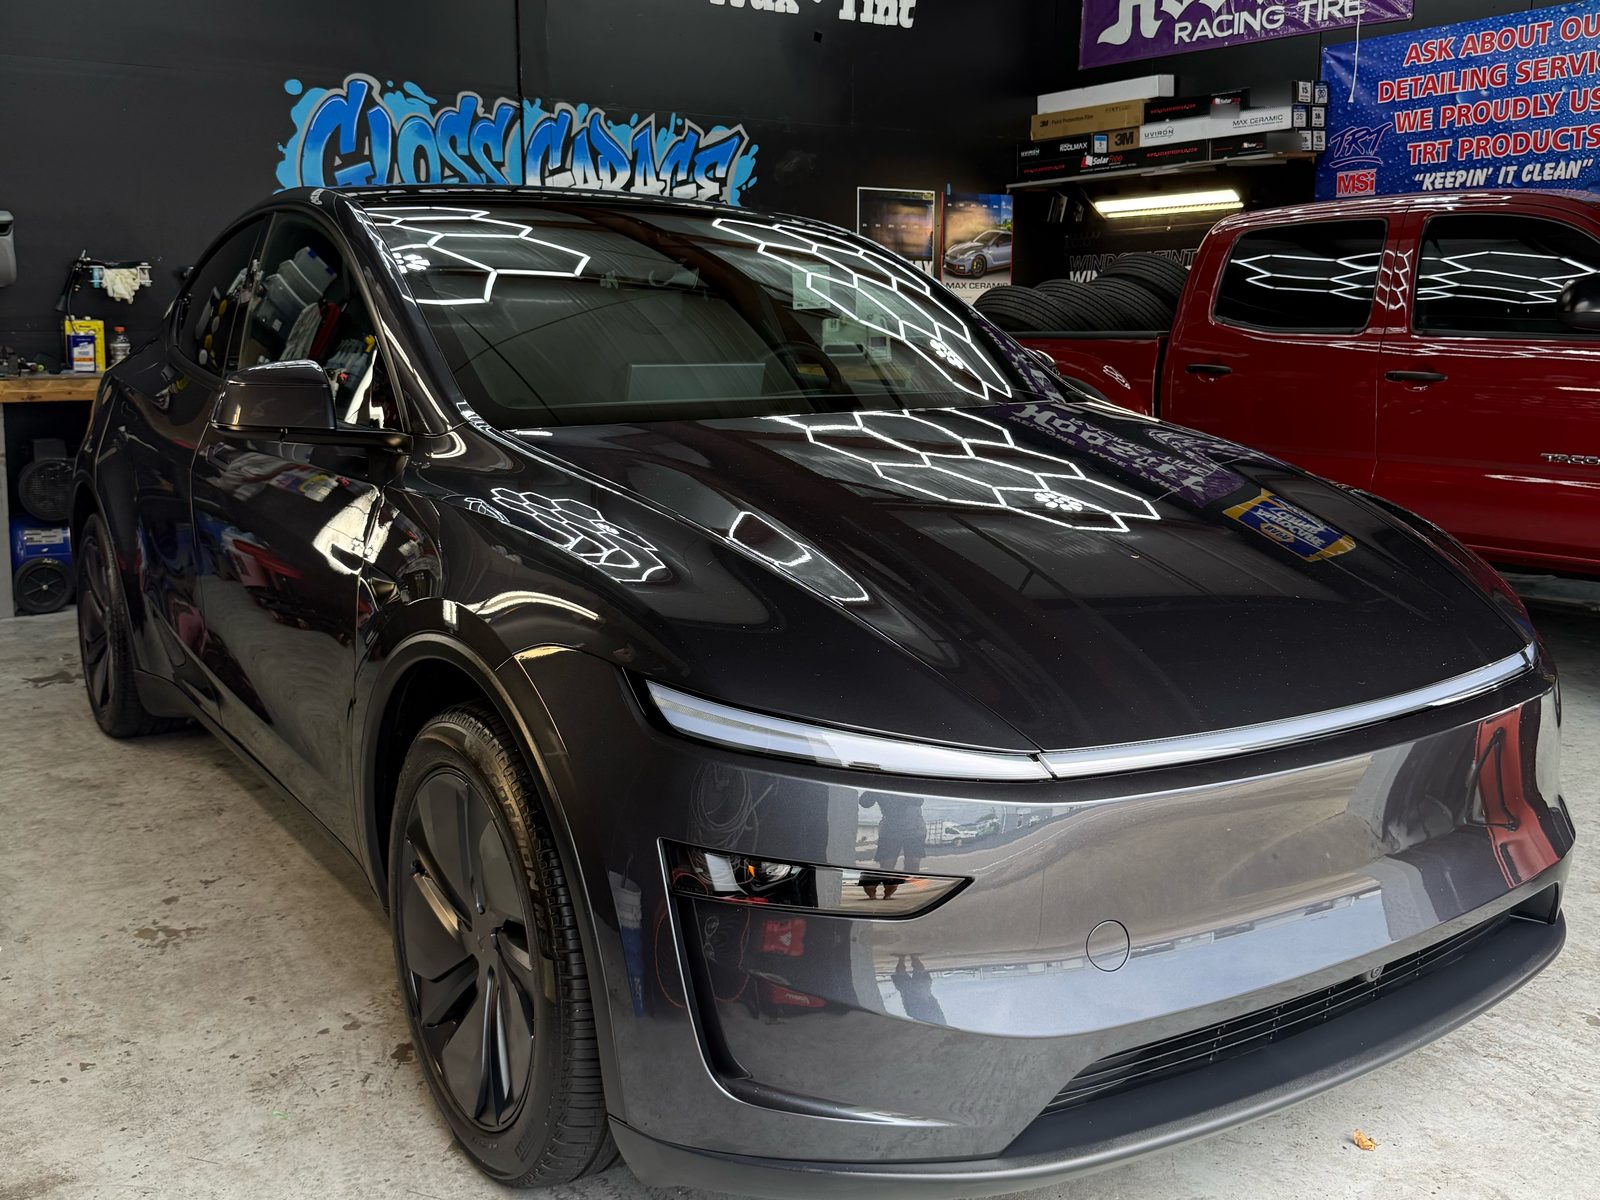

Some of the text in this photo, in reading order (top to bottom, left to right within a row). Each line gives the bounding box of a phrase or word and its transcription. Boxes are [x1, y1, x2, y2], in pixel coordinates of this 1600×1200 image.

[1174, 6, 1284, 45] RACING
[1301, 0, 1366, 23] TIRE
[1403, 37, 1455, 66] ASK
[1459, 20, 1553, 57] ABOUT
[1378, 63, 1508, 104] DETAILING
[1232, 118, 1249, 128] MAX
[1250, 114, 1284, 125] CERAMIC
[1395, 109, 1433, 133] WE
[1440, 92, 1564, 128] PROUDLY
[1114, 131, 1134, 147] 3M
[1330, 121, 1393, 160] TRT
[1408, 123, 1600, 165] TRT PRODUCTS
[1497, 165, 1518, 185] IT
[946, 282, 967, 290] MAX
[1540, 452, 1600, 466] TACO
